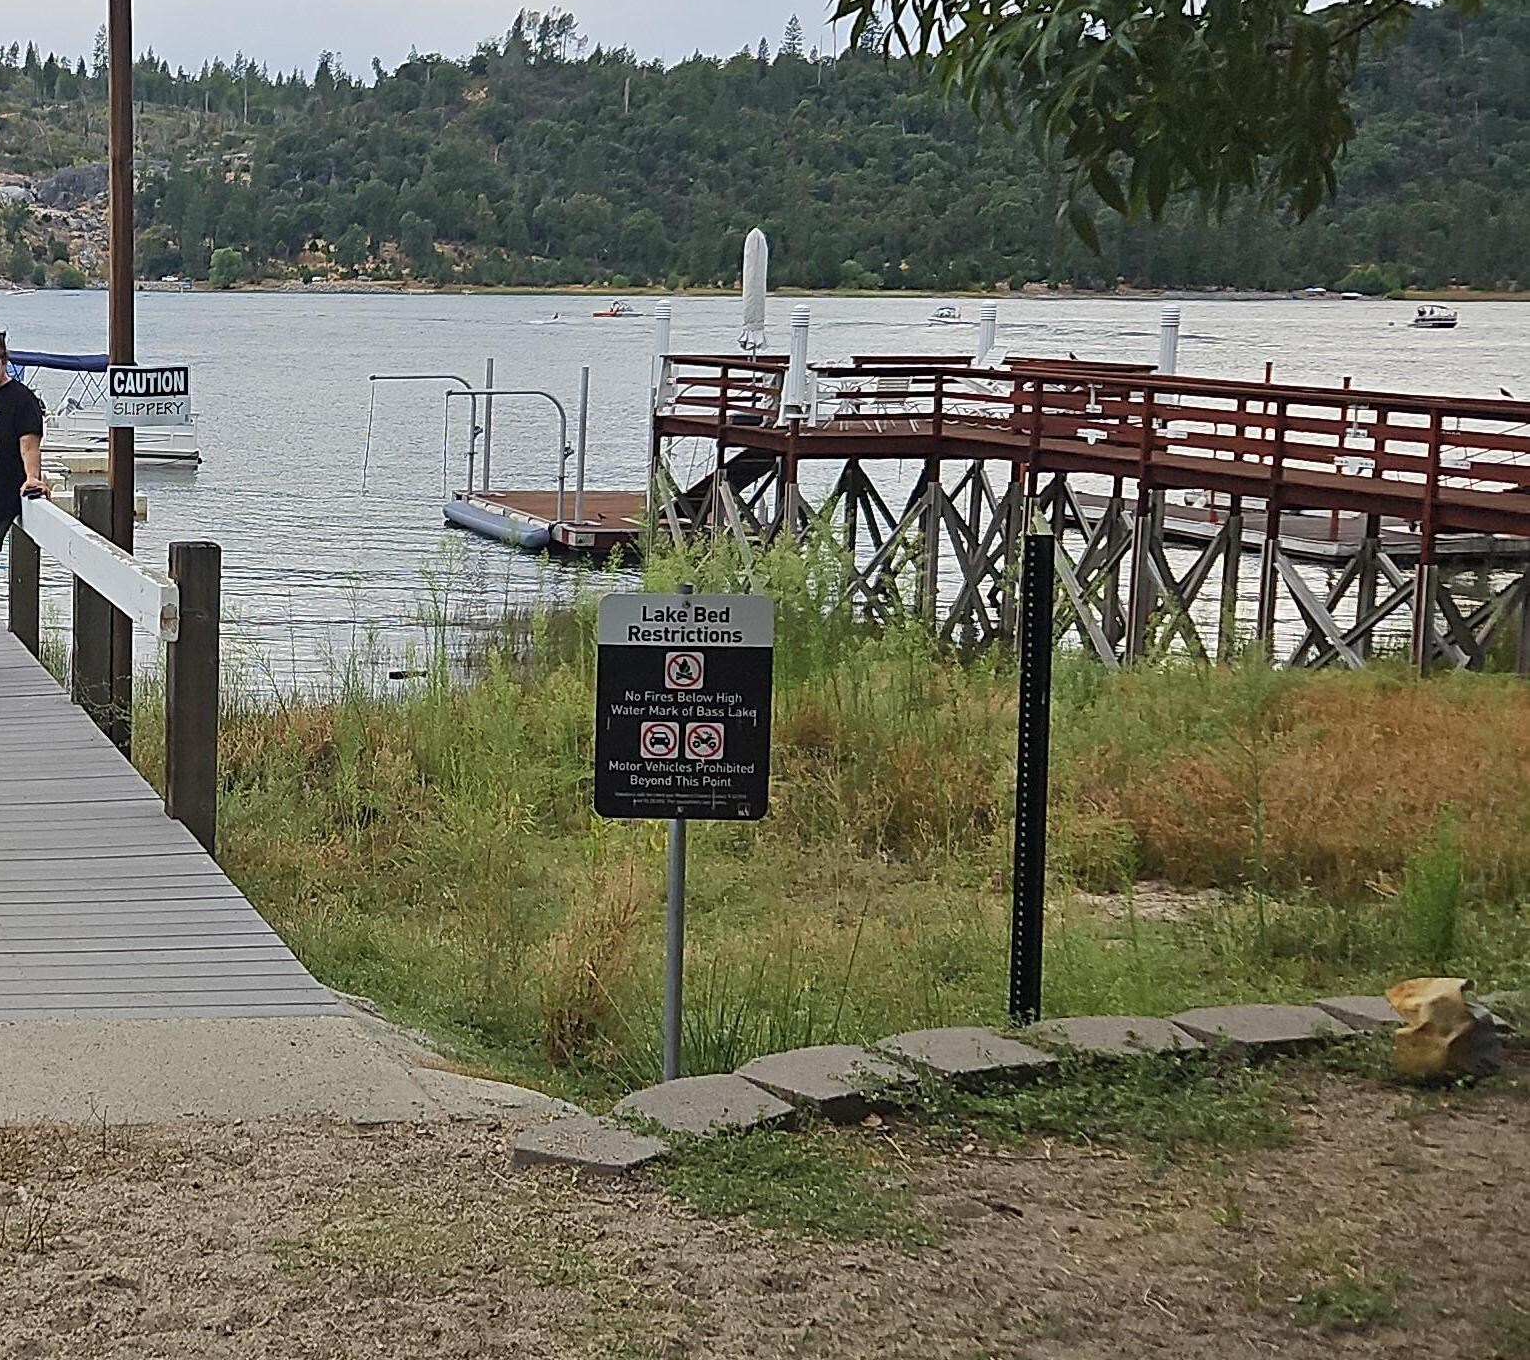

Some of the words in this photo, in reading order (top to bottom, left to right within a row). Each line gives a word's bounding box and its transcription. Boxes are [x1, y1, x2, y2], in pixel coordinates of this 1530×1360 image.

[113, 371, 185, 394] CAUTION
[113, 401, 184, 415] SLIPPERY
[642, 605, 688, 622] Lake
[694, 606, 730, 623] Bed
[628, 625, 743, 643] Restrictions
[625, 690, 641, 701] No
[644, 691, 674, 702] Fires
[677, 692, 713, 703] Below
[716, 692, 743, 705] High
[611, 704, 646, 716] Water
[649, 705, 679, 716] Mark
[681, 705, 693, 716] of
[696, 706, 725, 717] Bass
[728, 706, 757, 717] Lake
[609, 760, 642, 772] Motor
[645, 761, 693, 773] Vehicles
[695, 762, 755, 774] Prohibited
[630, 775, 672, 788] Beyond
[674, 776, 699, 787] This
[702, 776, 731, 788] Point
